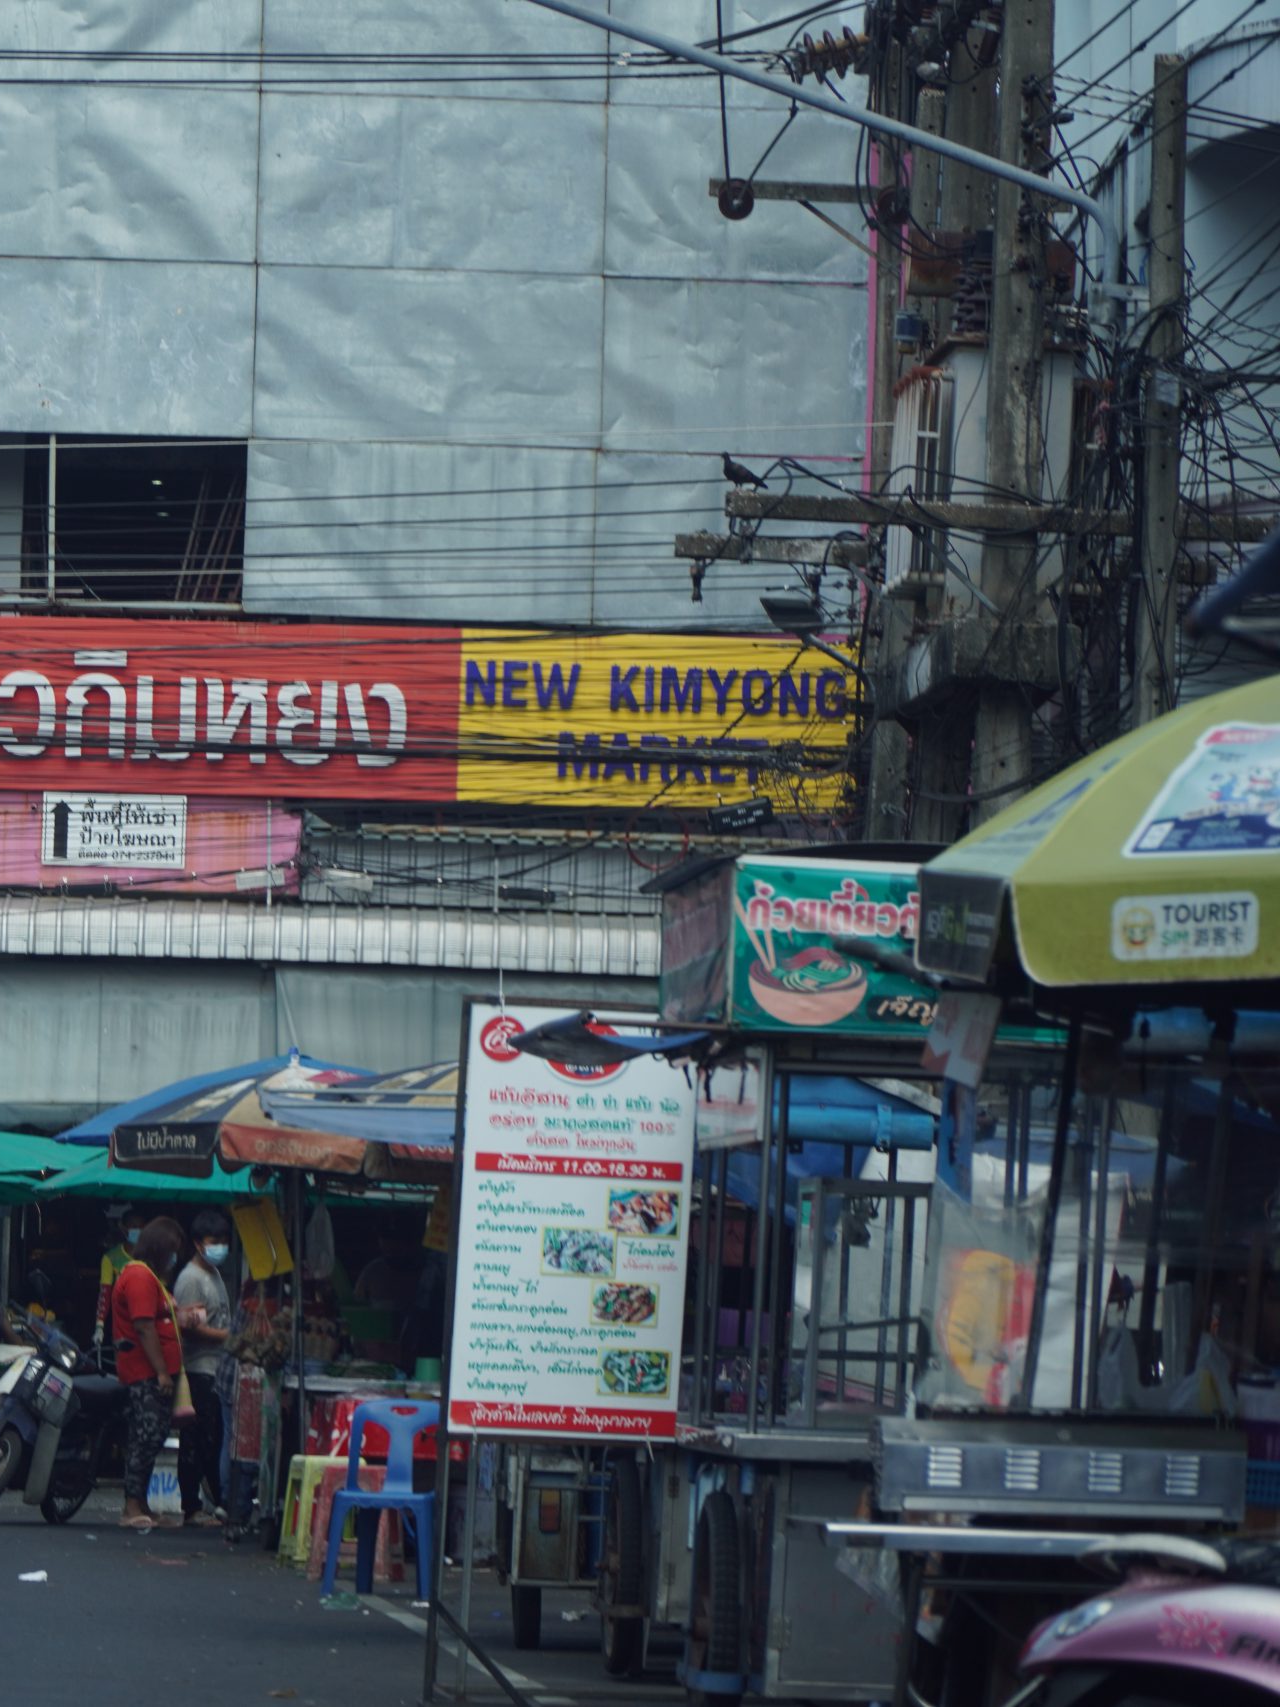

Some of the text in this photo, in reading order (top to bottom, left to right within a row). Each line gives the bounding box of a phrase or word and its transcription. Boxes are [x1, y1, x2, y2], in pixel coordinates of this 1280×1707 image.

[465, 660, 851, 718] NEW KIMYONG
[556, 731, 768, 784] MARKET
[80, 798, 177, 826] พื้นที่ให้เช่า
[80, 825, 176, 848] ป้ายโฆษณา
[1162, 901, 1251, 924] TOURIST
[1161, 929, 1190, 947] SIM
[576, 1092, 594, 1107] ตำ
[489, 1111, 535, 1128] อร่อย
[640, 1120, 675, 1135] 100%
[136, 1126, 197, 1151] ไม่มีน้ำตาล
